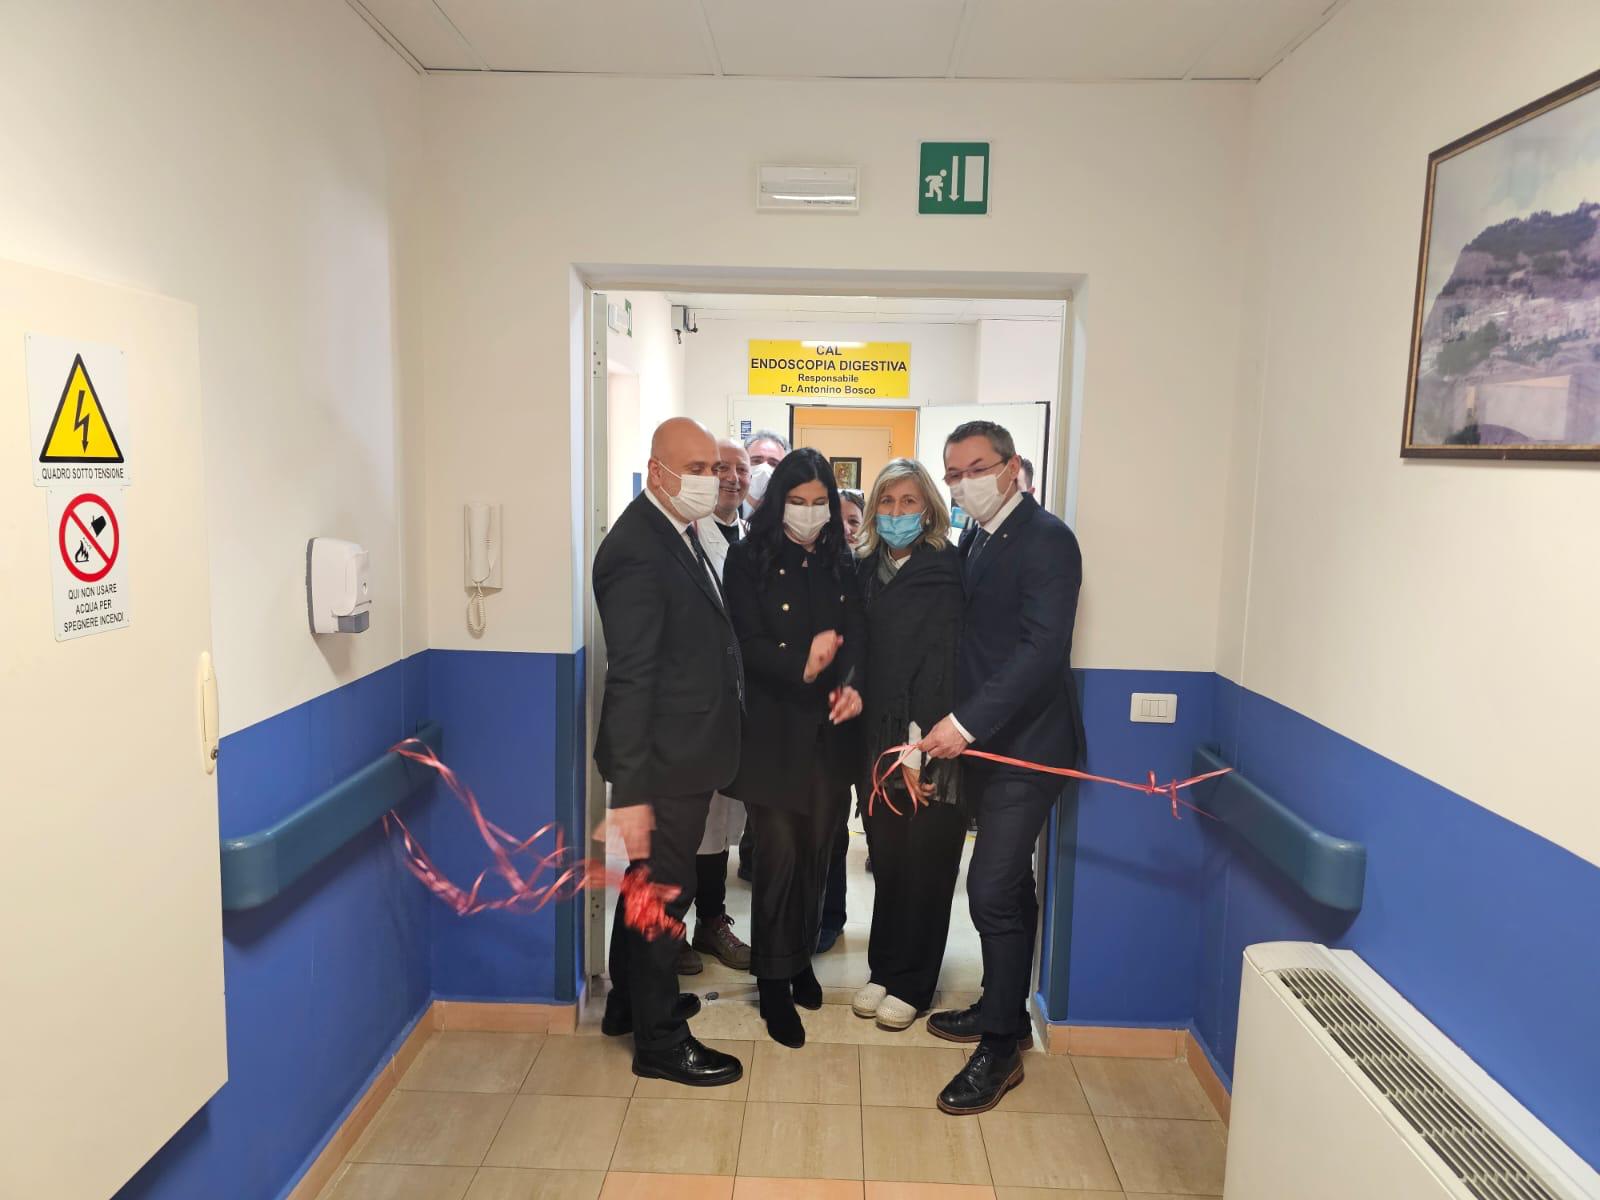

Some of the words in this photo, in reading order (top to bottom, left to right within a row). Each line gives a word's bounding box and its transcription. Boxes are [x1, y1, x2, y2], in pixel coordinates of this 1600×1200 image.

[816, 345, 843, 356] CAL
[751, 359, 836, 371] ENDOSCOPIA
[839, 360, 907, 372] DIGESTIVA
[798, 373, 859, 383] Responsabile
[780, 384, 794, 393] Dr.
[796, 384, 842, 394] Antonino
[844, 385, 876, 395] Bosco
[42, 468, 71, 479] QUADRO
[72, 468, 93, 479] SOTTO
[94, 468, 124, 479] TENSIONE
[68, 589, 80, 600] QUI
[81, 587, 95, 598] NON
[96, 583, 117, 596] USARE
[76, 601, 98, 615] ACQUA
[99, 599, 112, 610] PER
[64, 616, 99, 633] SPEGNERE
[100, 611, 124, 626] INCENDI
